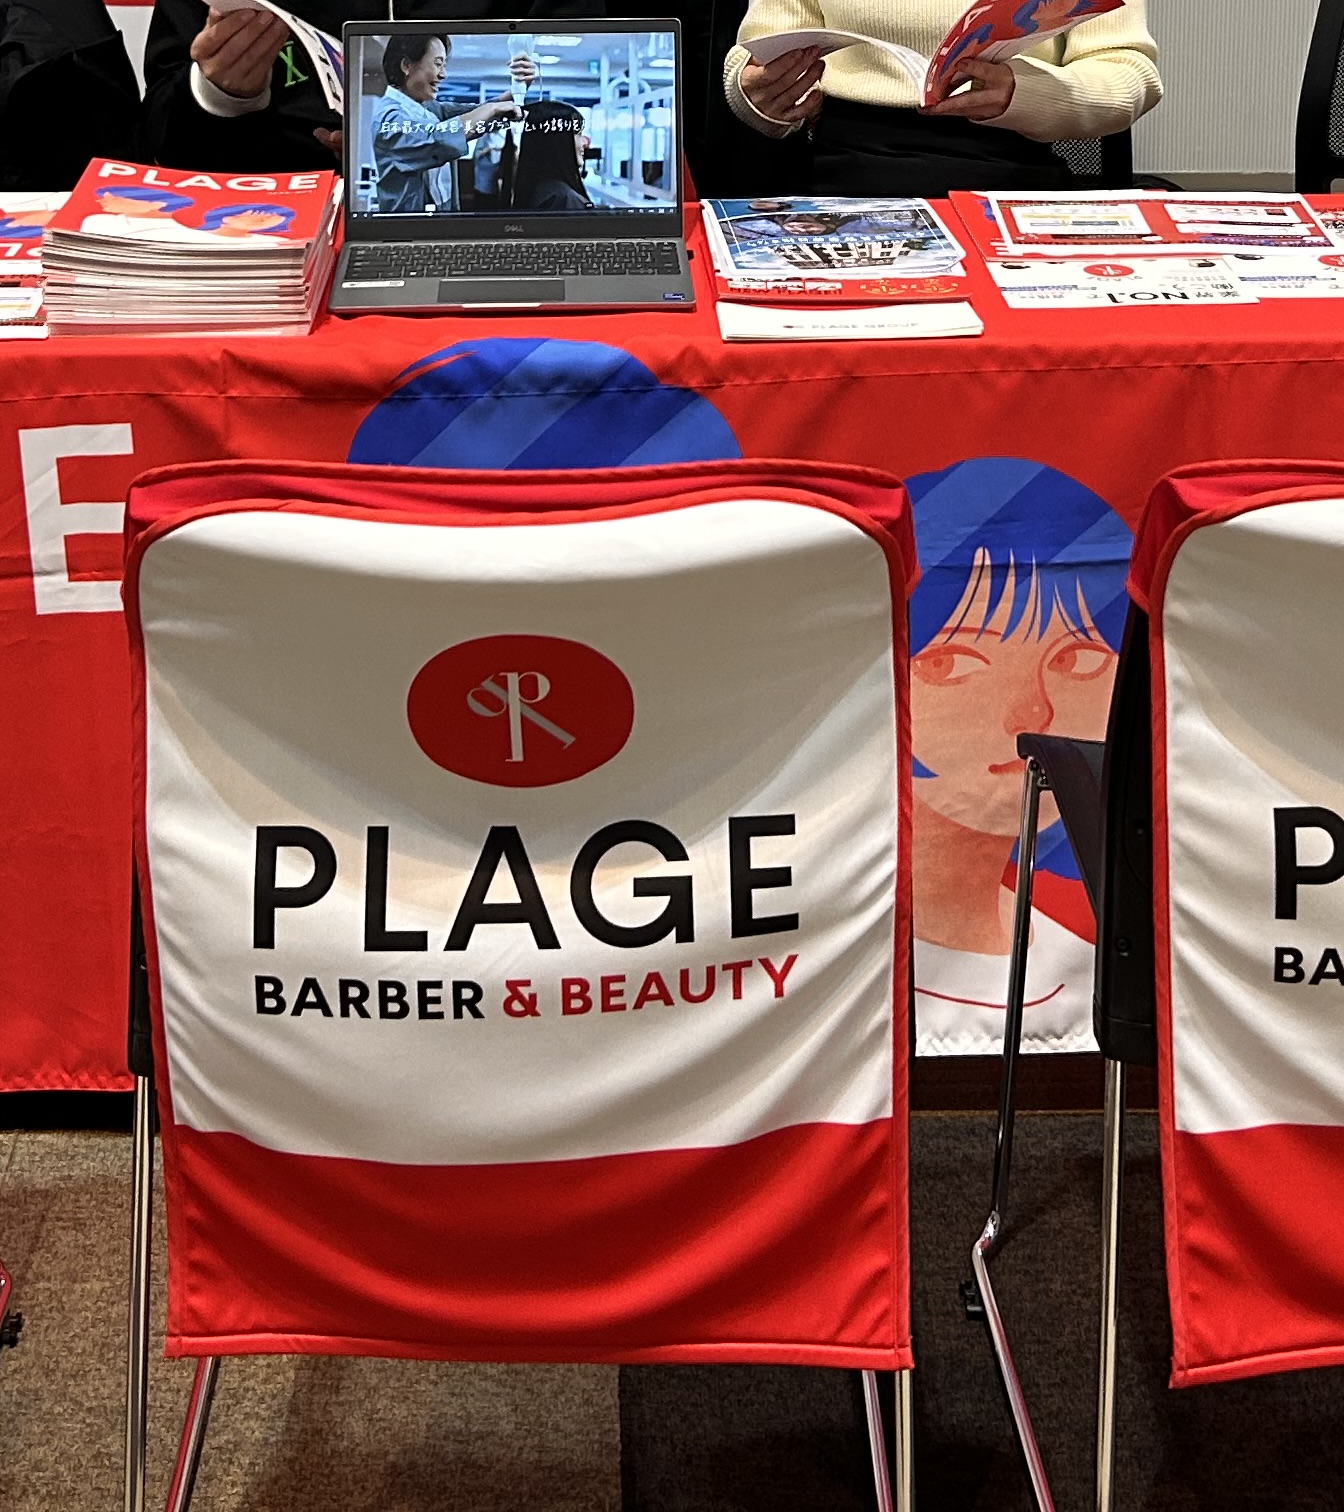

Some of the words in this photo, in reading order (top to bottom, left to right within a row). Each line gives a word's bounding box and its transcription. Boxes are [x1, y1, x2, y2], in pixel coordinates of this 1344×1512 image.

[97, 162, 321, 192] PLAGE
[254, 814, 799, 952] PLAGE
[255, 974, 485, 1020] BARBER
[503, 978, 541, 1019] &
[561, 954, 799, 1016] BEAUTY
